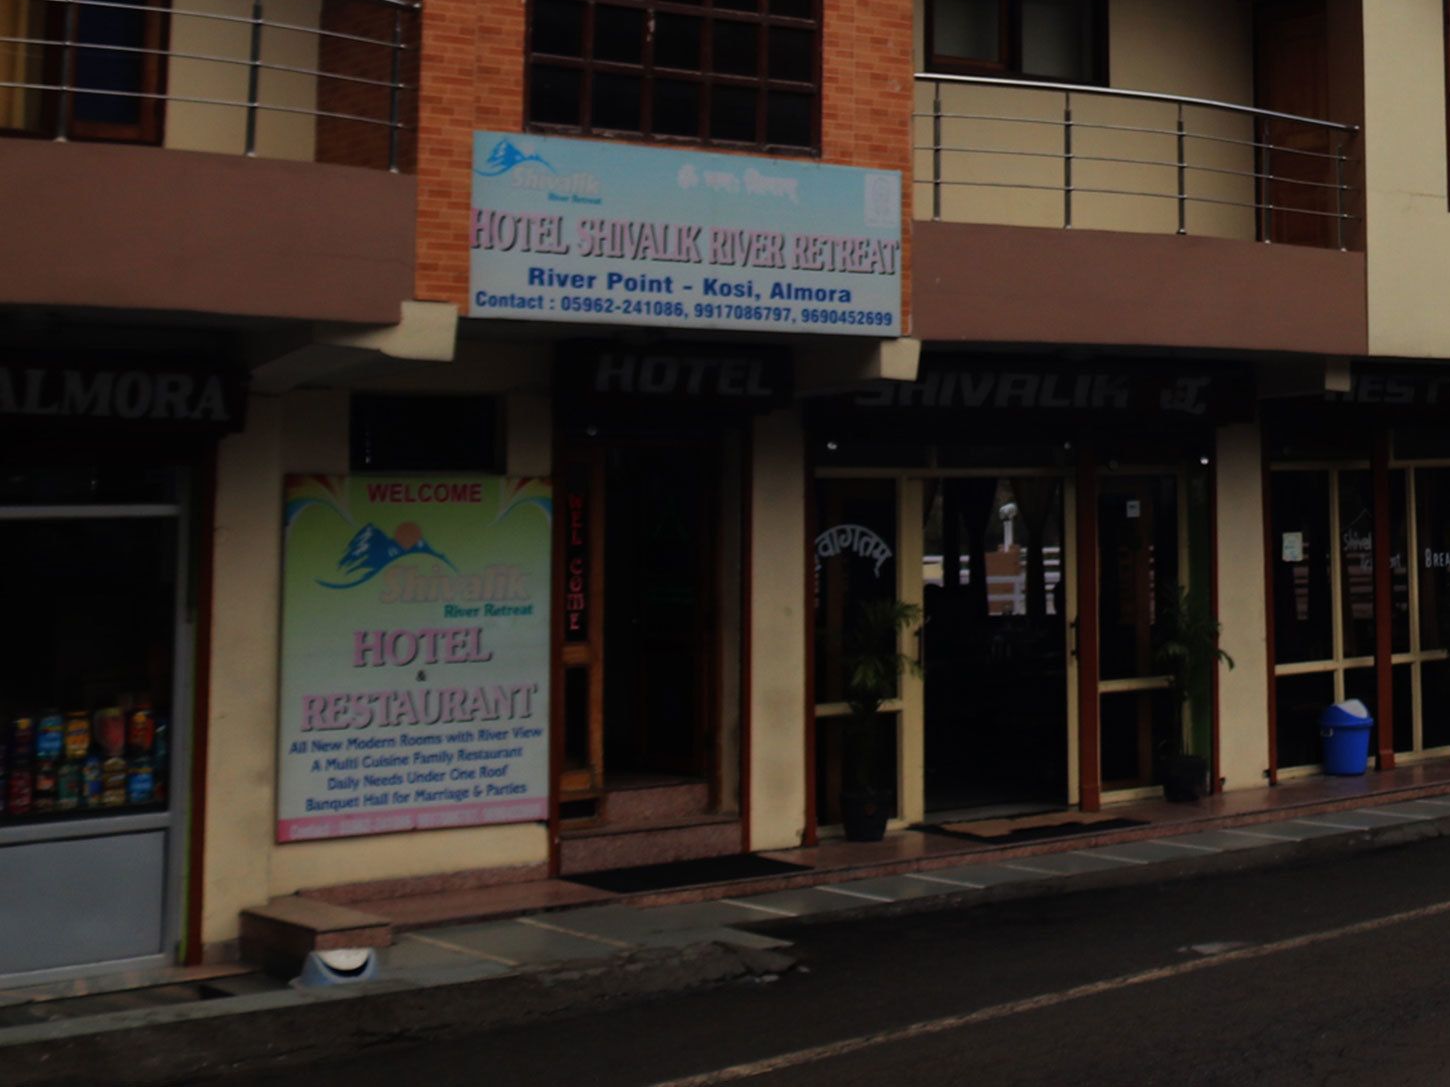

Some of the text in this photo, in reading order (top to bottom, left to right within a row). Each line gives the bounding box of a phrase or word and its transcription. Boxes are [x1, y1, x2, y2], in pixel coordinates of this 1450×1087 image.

[471, 208, 900, 275] HOTEL SHIVALIK RIVER RETREAT
[528, 267, 596, 288] River
[607, 273, 674, 294] Point
[703, 278, 760, 300] Kosi,
[770, 281, 852, 302] Almora
[475, 291, 544, 310] Contact
[561, 295, 689, 319] 05962-241086,
[694, 303, 797, 323] 9917086797,
[801, 308, 893, 326] 9690452699
[594, 353, 774, 397] HOTEL
[368, 483, 482, 503] WELCOME
[381, 563, 531, 604] Shivalik
[443, 603, 533, 618] River Retreat
[353, 627, 493, 668] HOTEL
[416, 669, 427, 682] &
[300, 683, 538, 732] RESTAURANT
[289, 727, 543, 754] All New Modern Rooms with River View
[311, 748, 523, 772] A Multi Cuisine Family Restaurant
[327, 764, 508, 791] Daily Needs Under One Roof
[306, 796, 359, 812] Banquet
[363, 793, 388, 806] Hall
[392, 791, 410, 804] for
[415, 788, 469, 802] Marriage
[486, 783, 527, 796] Parties
